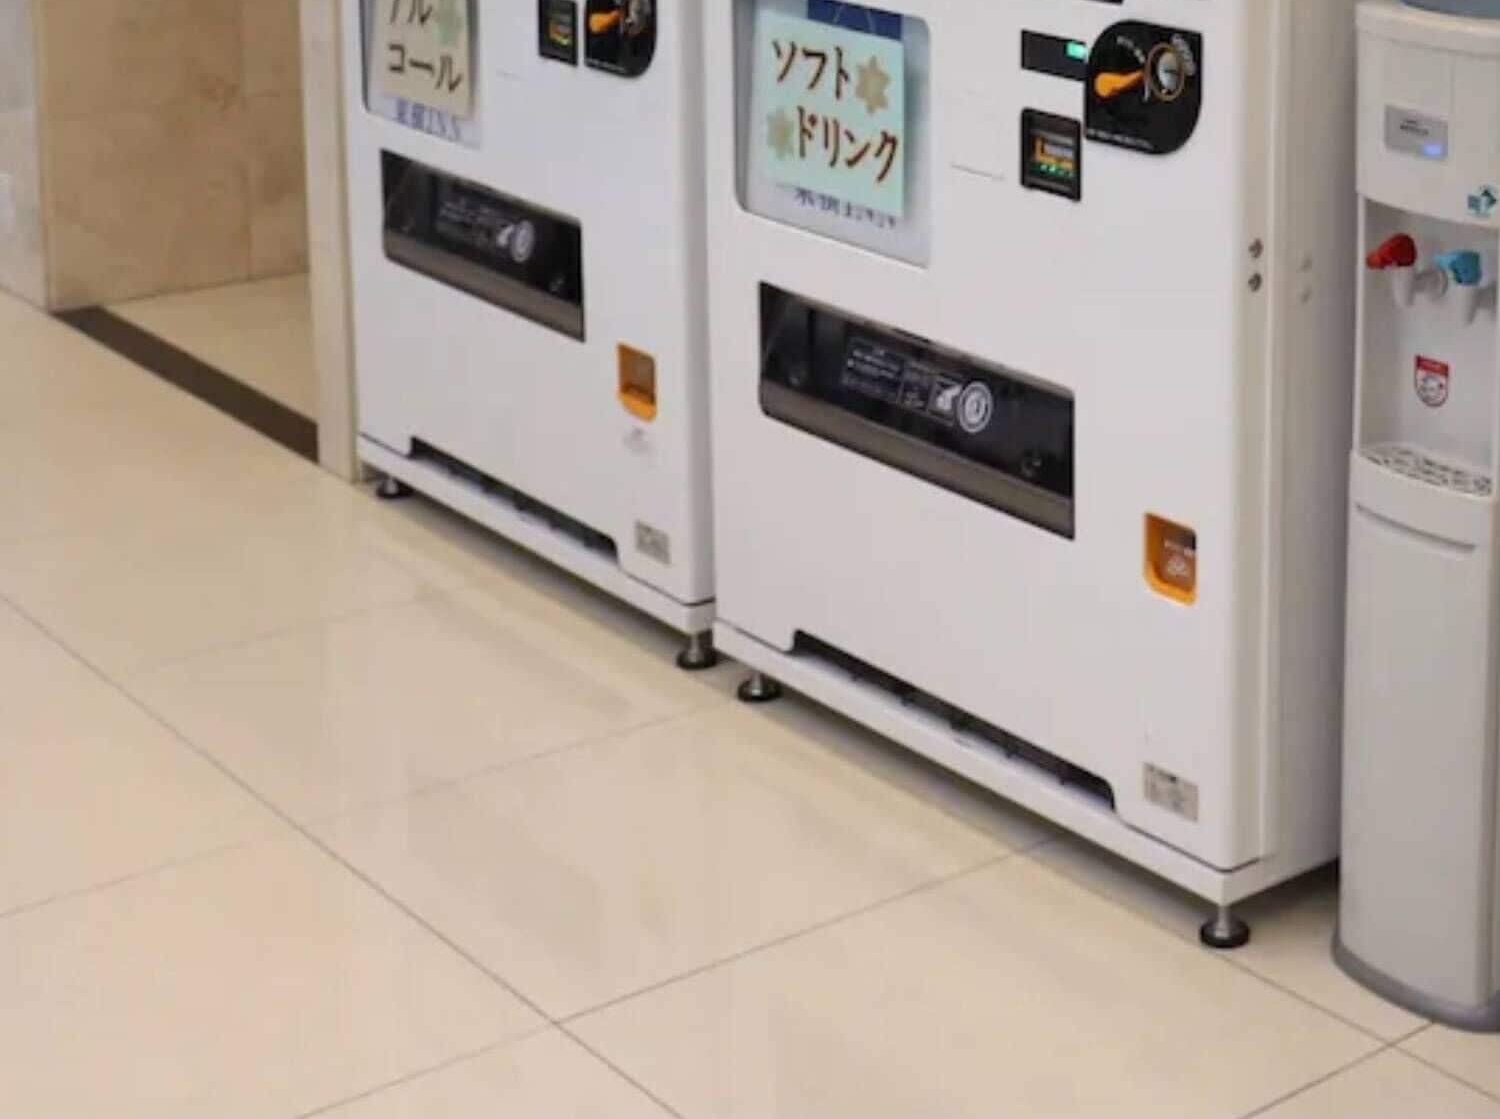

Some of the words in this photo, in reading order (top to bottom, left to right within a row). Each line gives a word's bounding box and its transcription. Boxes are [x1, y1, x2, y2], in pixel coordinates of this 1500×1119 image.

[386, 42, 465, 94] コール
[771, 38, 850, 99] ソフト
[793, 105, 899, 185] ドリンク
